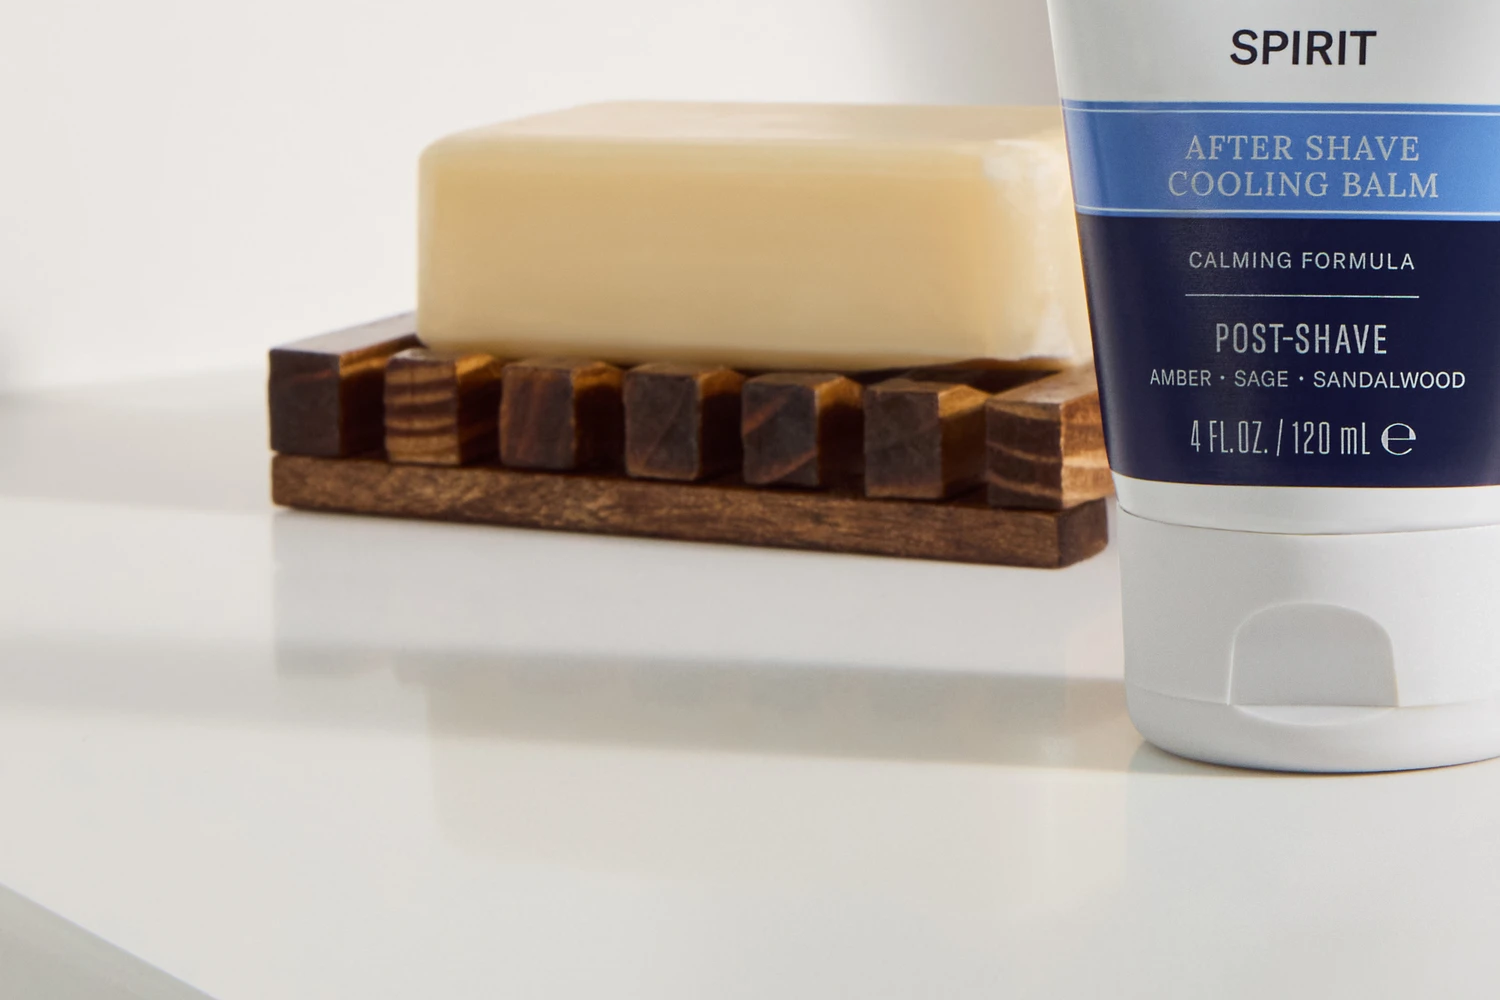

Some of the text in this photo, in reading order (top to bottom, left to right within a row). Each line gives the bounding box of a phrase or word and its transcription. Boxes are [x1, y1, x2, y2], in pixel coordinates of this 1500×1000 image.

[1229, 28, 1378, 66] SPIRIT
[1184, 134, 1420, 162] AFTER SHAVE
[1168, 170, 1440, 199] COOLING BALM
[1188, 250, 1415, 271] CALMING FORMULA
[1215, 322, 1387, 355] POST-SHAVE
[1149, 368, 1466, 389] AMBER SAGE SANDALWOOD
[1190, 419, 1201, 453] 4
[1292, 421, 1330, 455] 120
[1340, 421, 1371, 455] mL
